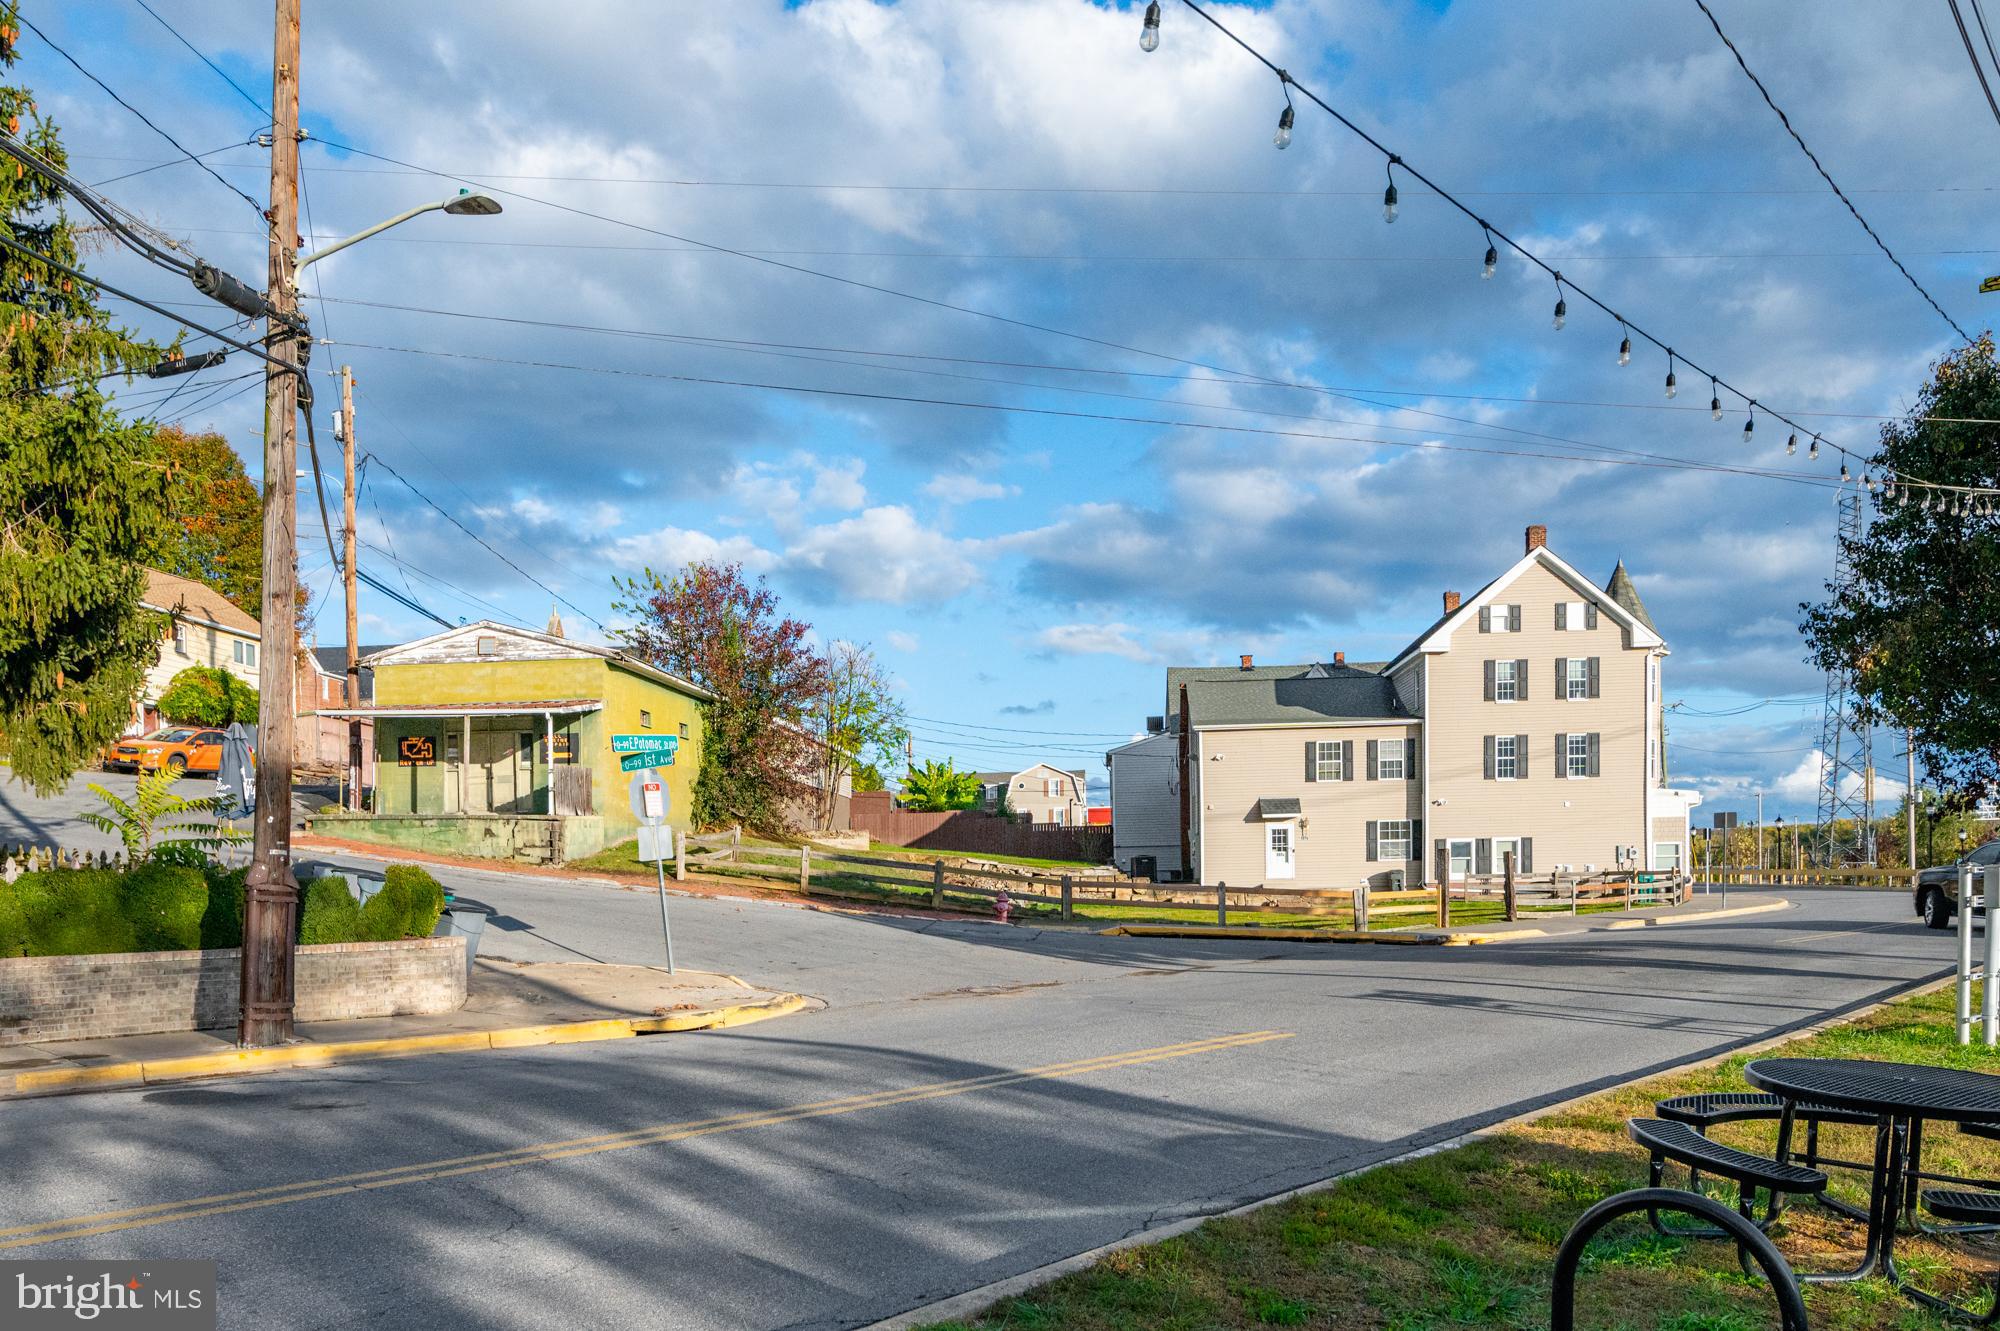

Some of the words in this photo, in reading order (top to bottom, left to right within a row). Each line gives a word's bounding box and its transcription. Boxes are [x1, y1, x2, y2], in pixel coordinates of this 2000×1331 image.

[624, 759, 642, 770] 0-99
[645, 754, 656, 766] 1st
[660, 755, 672, 764] Ave
